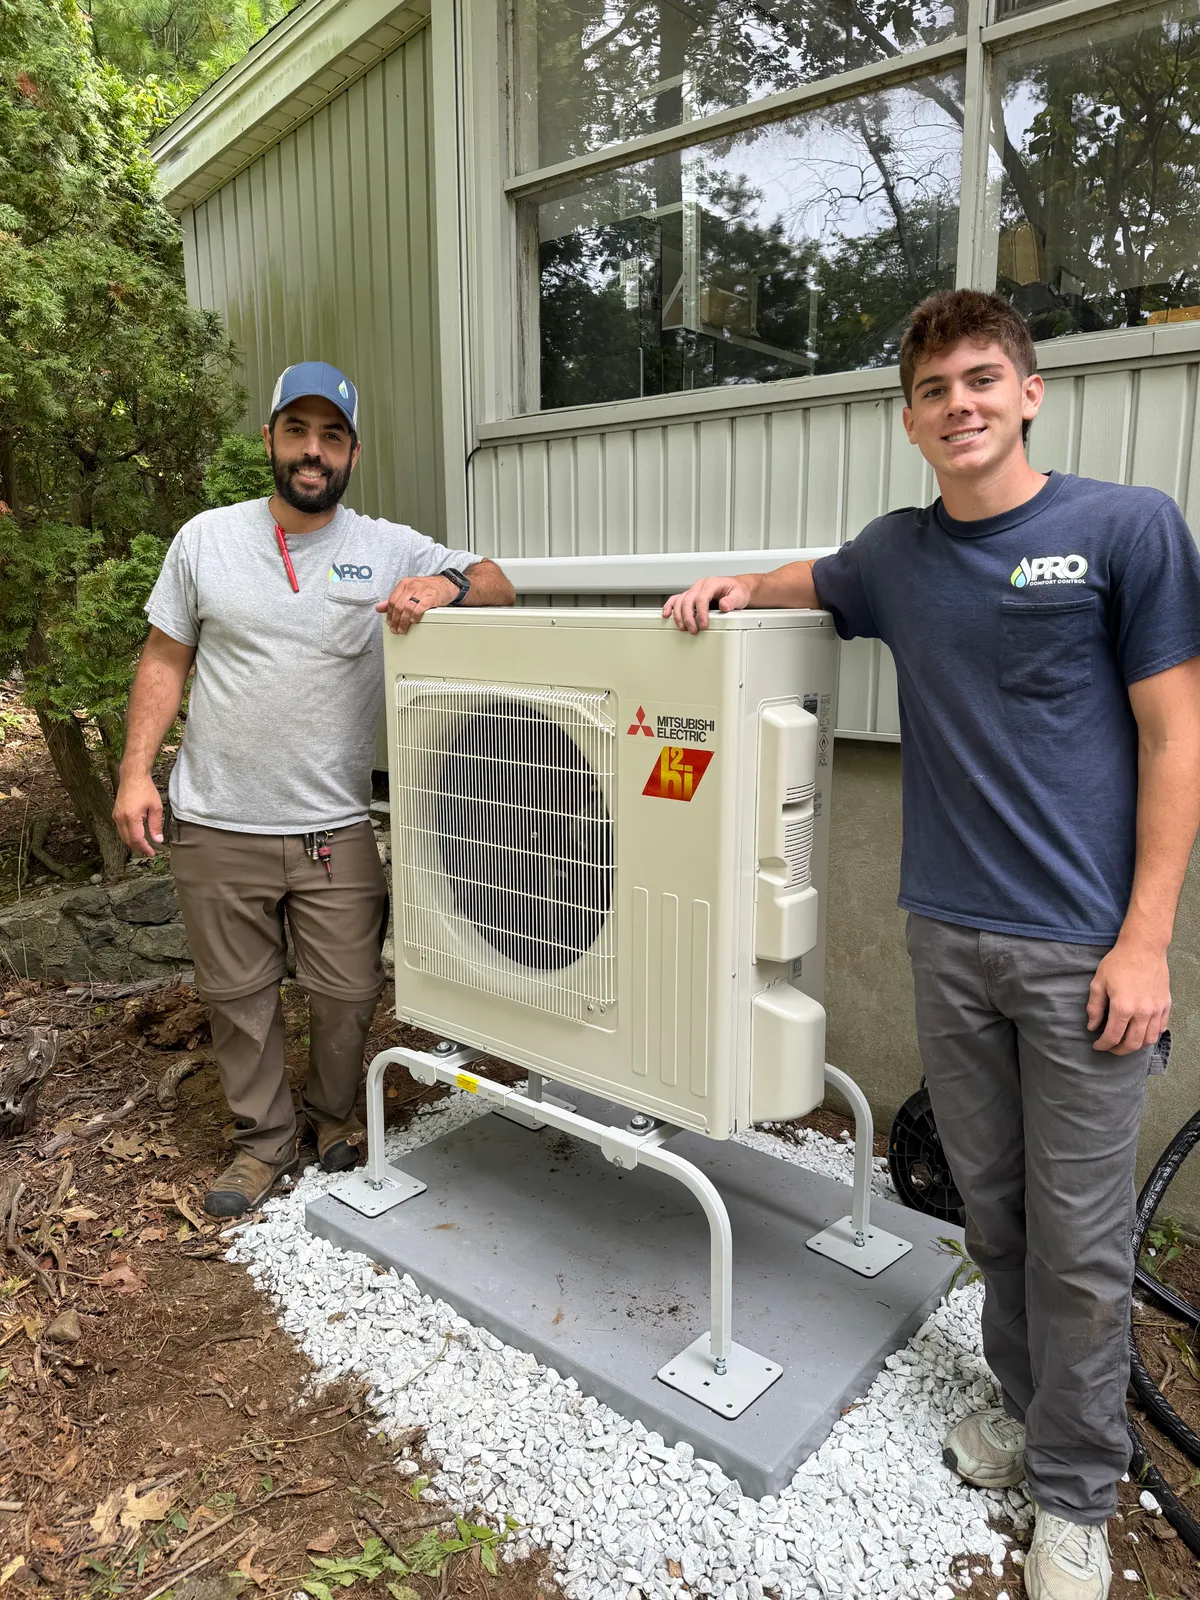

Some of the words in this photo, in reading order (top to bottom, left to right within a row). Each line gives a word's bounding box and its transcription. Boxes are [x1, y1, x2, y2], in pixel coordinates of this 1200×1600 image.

[340, 564, 373, 580] PRO
[1031, 554, 1088, 581] PRO
[1029, 579, 1056, 587] COMFORT
[656, 715, 715, 732] MITSUBISHI
[656, 727, 707, 743] ELECTRIC
